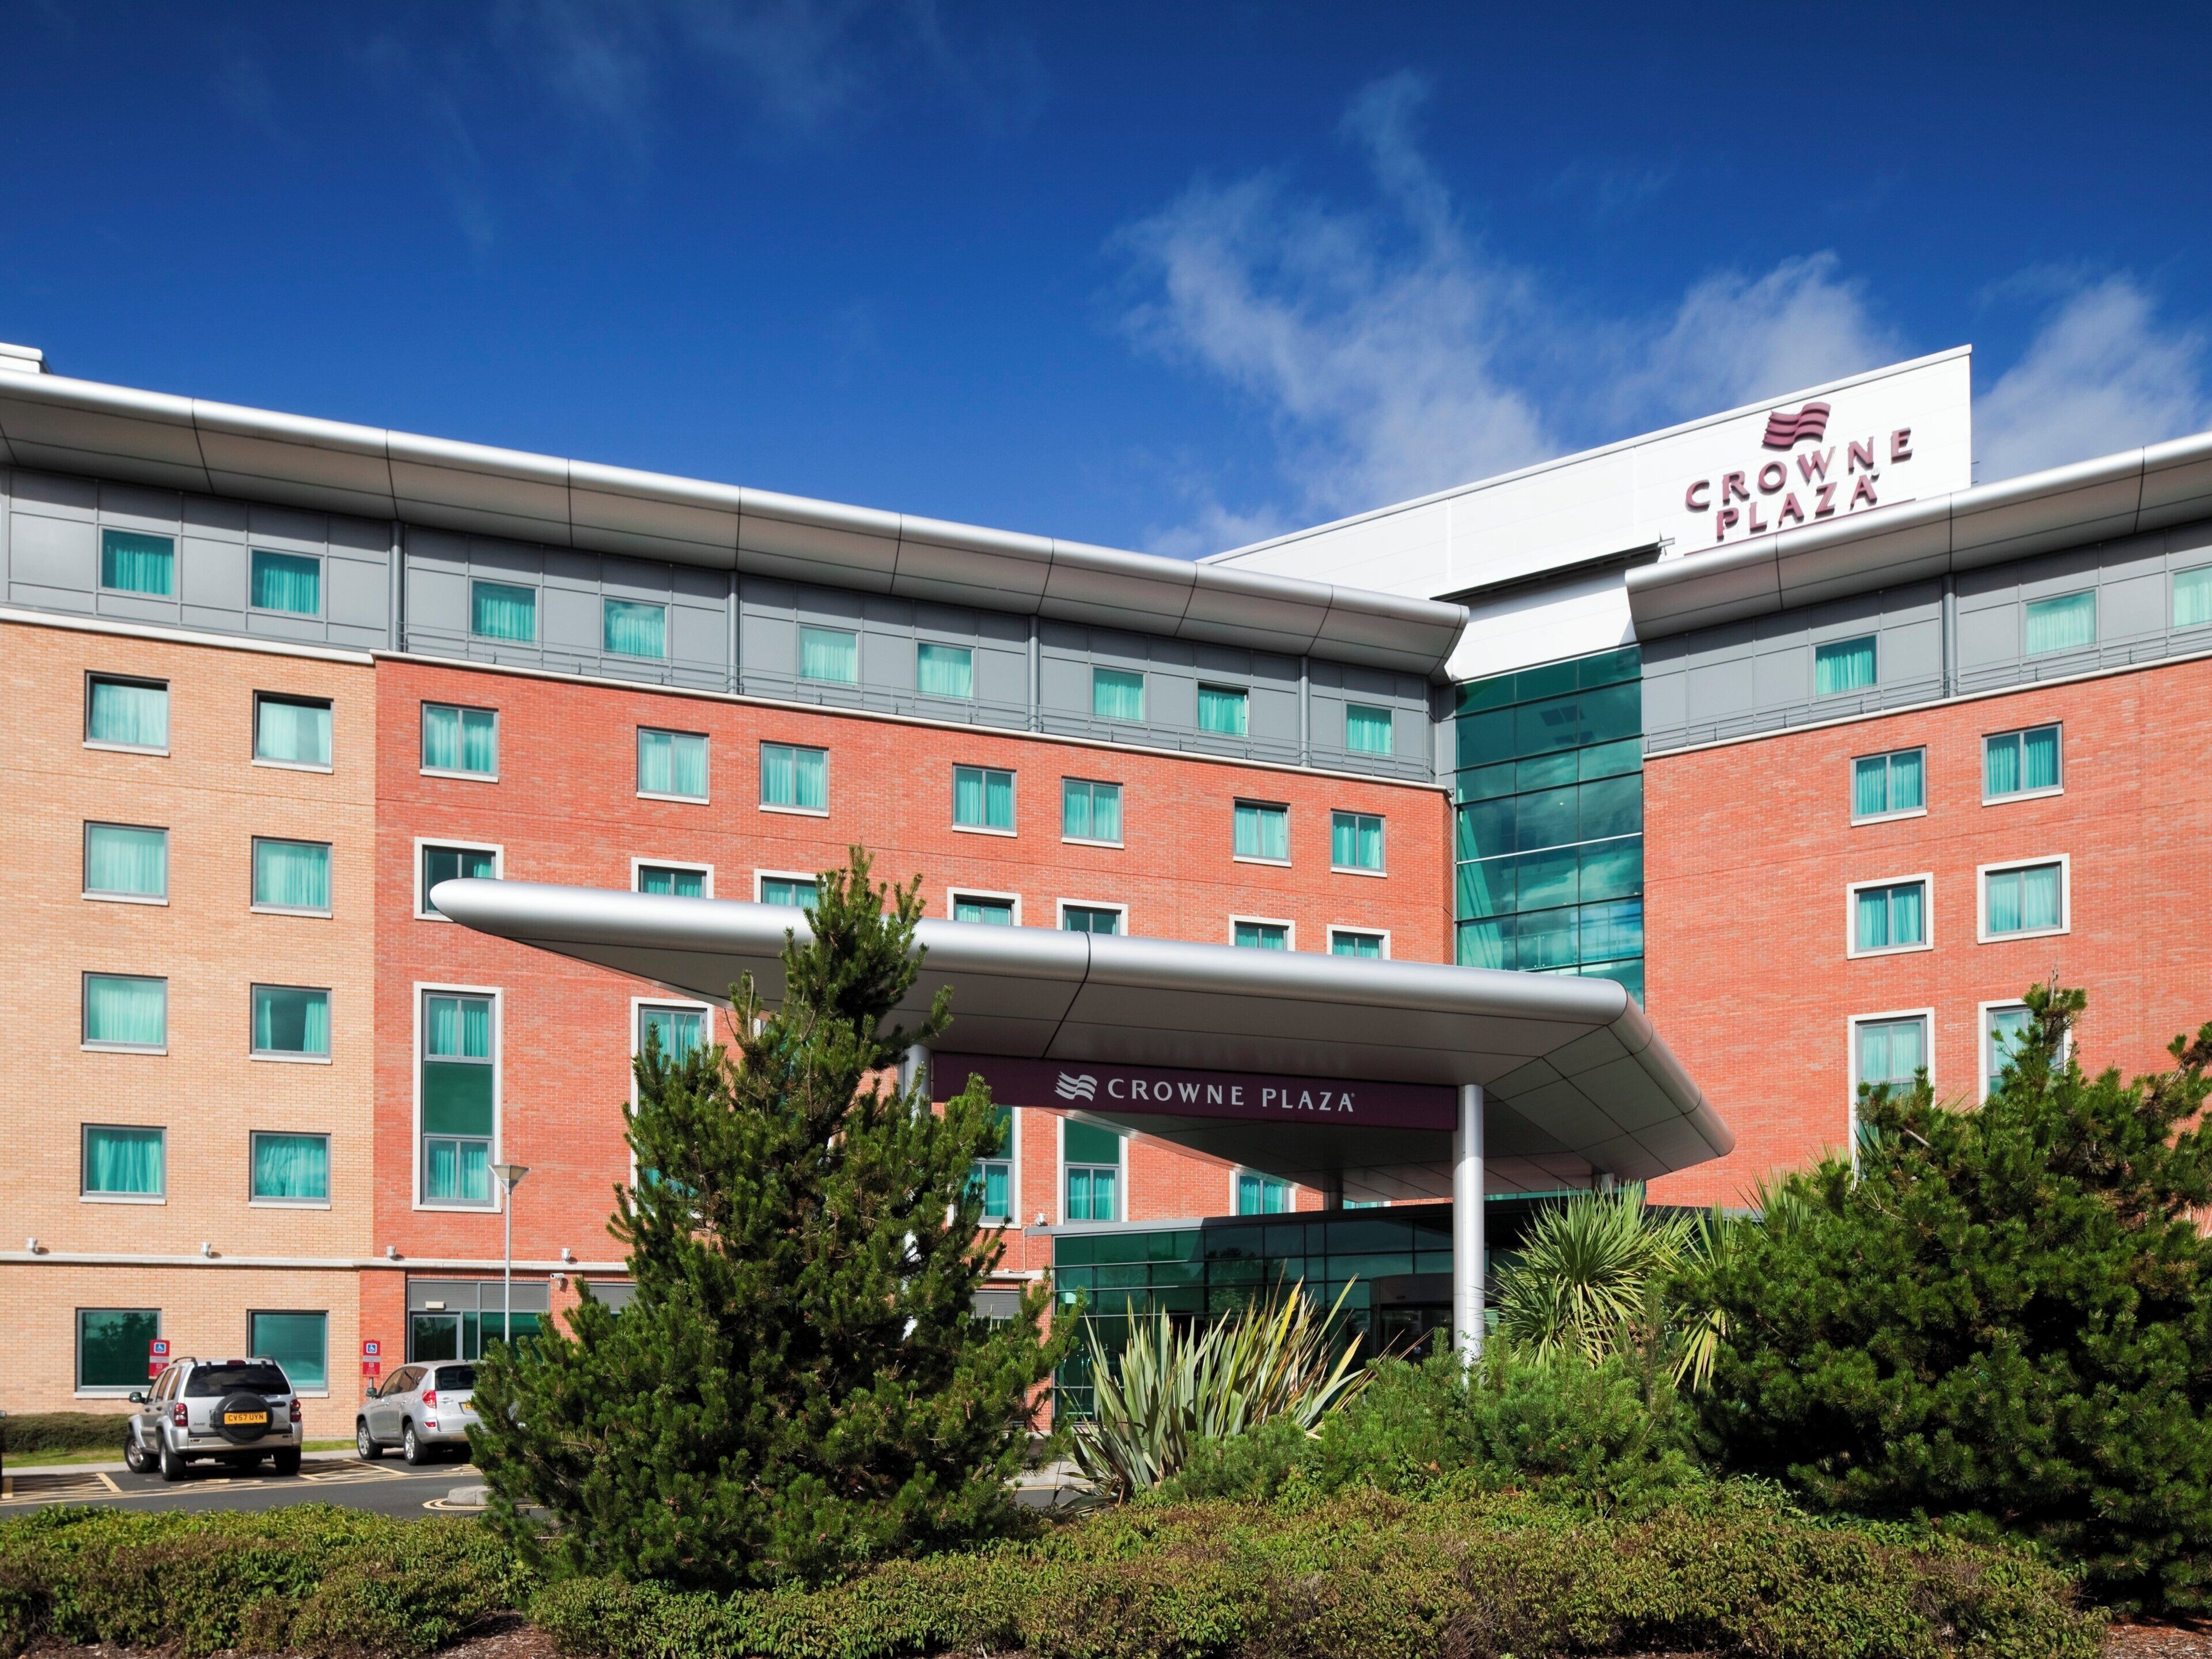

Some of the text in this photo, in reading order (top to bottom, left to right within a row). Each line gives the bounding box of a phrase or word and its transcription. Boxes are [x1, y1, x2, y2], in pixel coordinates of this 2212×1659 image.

[1685, 427, 1913, 512] CROWNE
[1717, 474, 1877, 542] PLAZA
[1107, 1078, 1354, 1112] CROWNE PLAZA
